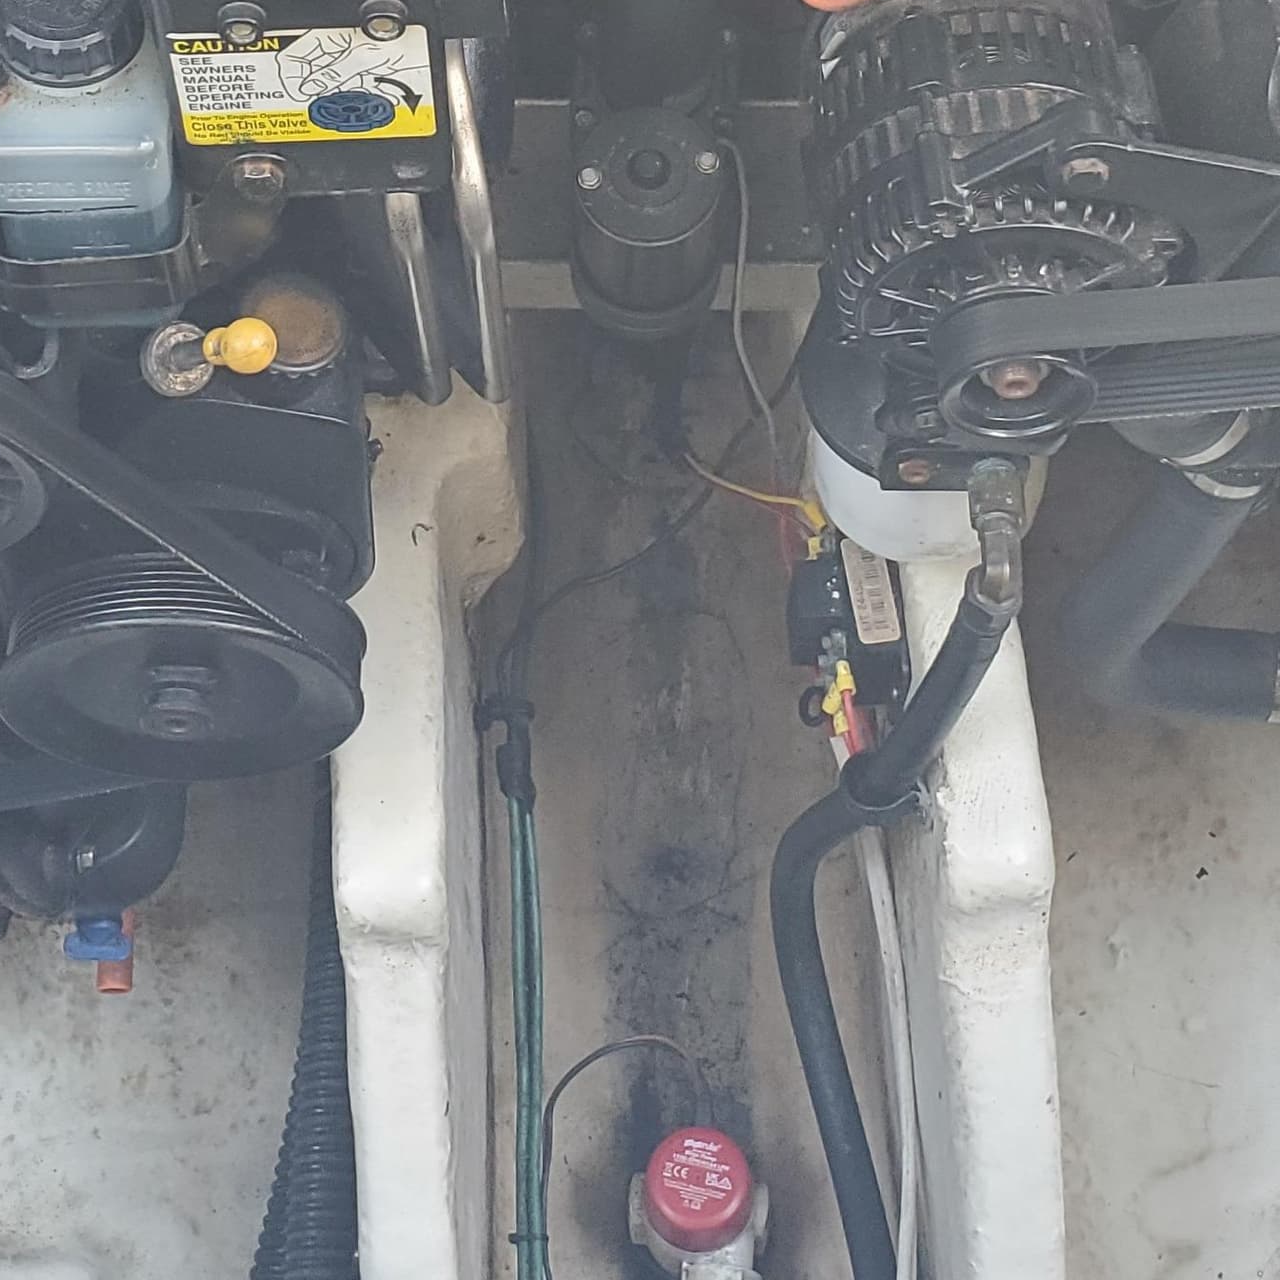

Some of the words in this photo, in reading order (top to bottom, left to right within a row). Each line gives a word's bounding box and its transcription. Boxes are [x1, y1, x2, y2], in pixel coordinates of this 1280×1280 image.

[179, 57, 213, 66] SEE
[181, 65, 257, 75] OWNERS
[183, 74, 256, 84] MANUAL
[185, 83, 255, 93] BEFORE
[187, 91, 284, 102] OPERATING
[189, 101, 252, 111] ENGINE
[227, 113, 258, 121] Engine
[260, 111, 304, 119] Operation
[191, 122, 232, 132] Close
[235, 120, 266, 130] This
[269, 119, 308, 128] Valve
